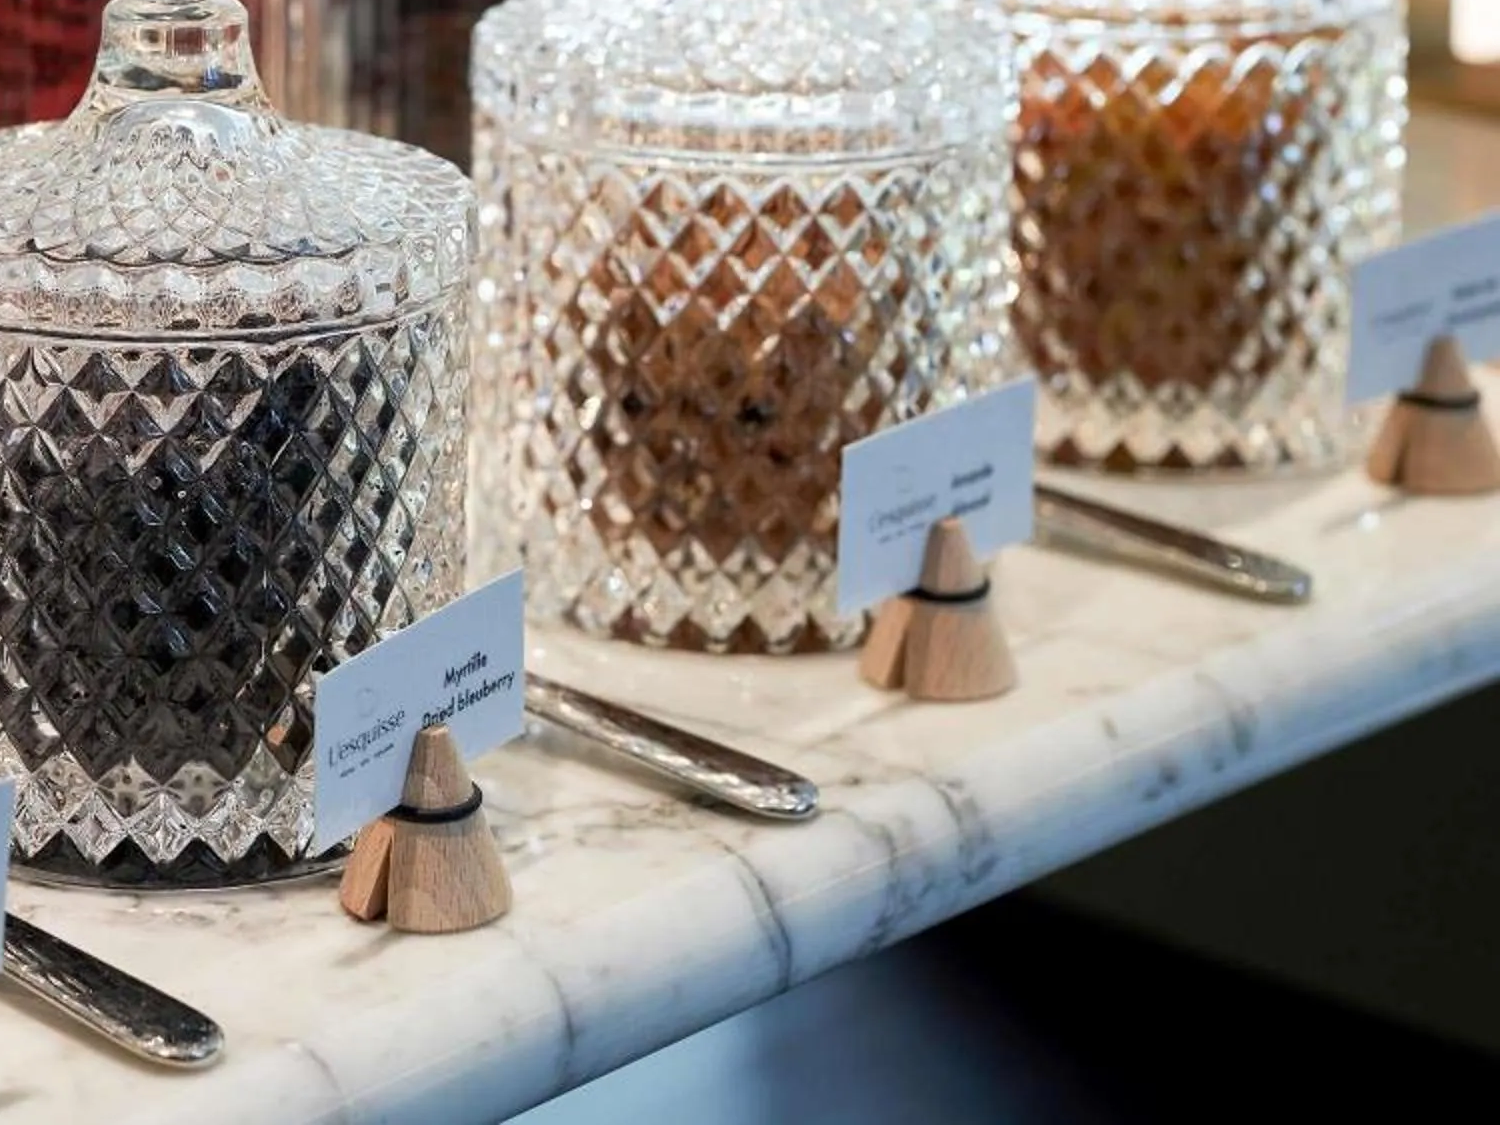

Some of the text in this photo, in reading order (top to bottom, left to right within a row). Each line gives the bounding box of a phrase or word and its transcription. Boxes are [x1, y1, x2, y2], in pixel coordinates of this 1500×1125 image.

[443, 651, 487, 689] Myrtille
[422, 671, 515, 730] Dried bleuberry
